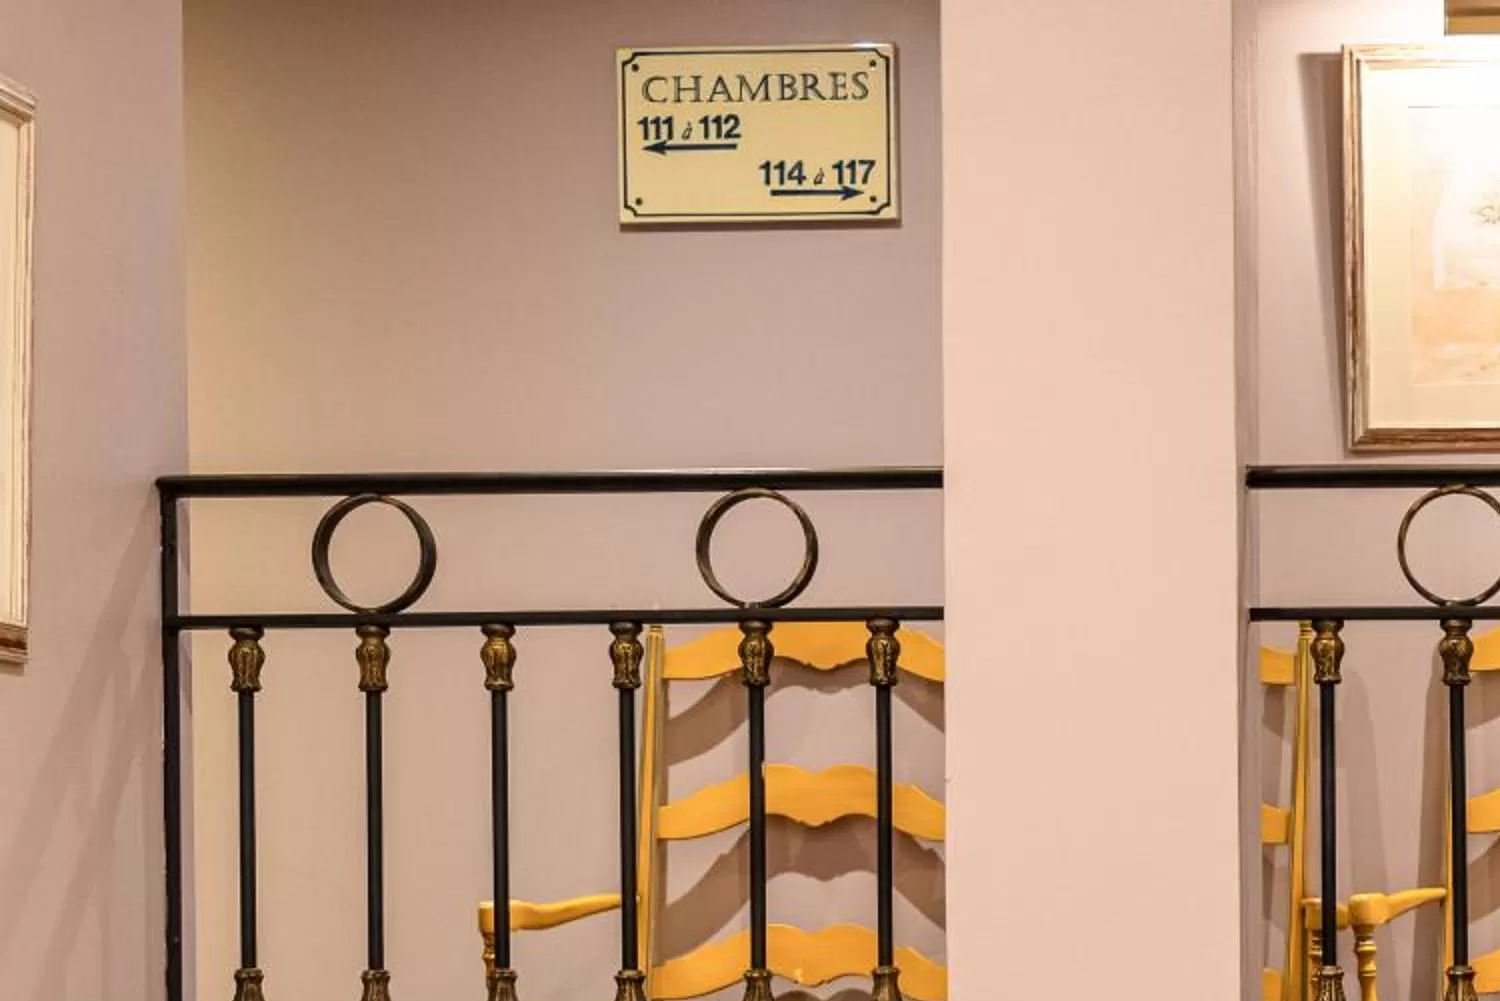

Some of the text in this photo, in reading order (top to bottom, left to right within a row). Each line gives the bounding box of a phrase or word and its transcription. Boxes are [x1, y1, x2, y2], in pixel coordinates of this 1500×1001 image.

[641, 71, 870, 104] CHAMBRES
[636, 113, 742, 141] 111 à 112
[758, 159, 876, 186] 114 à 117
